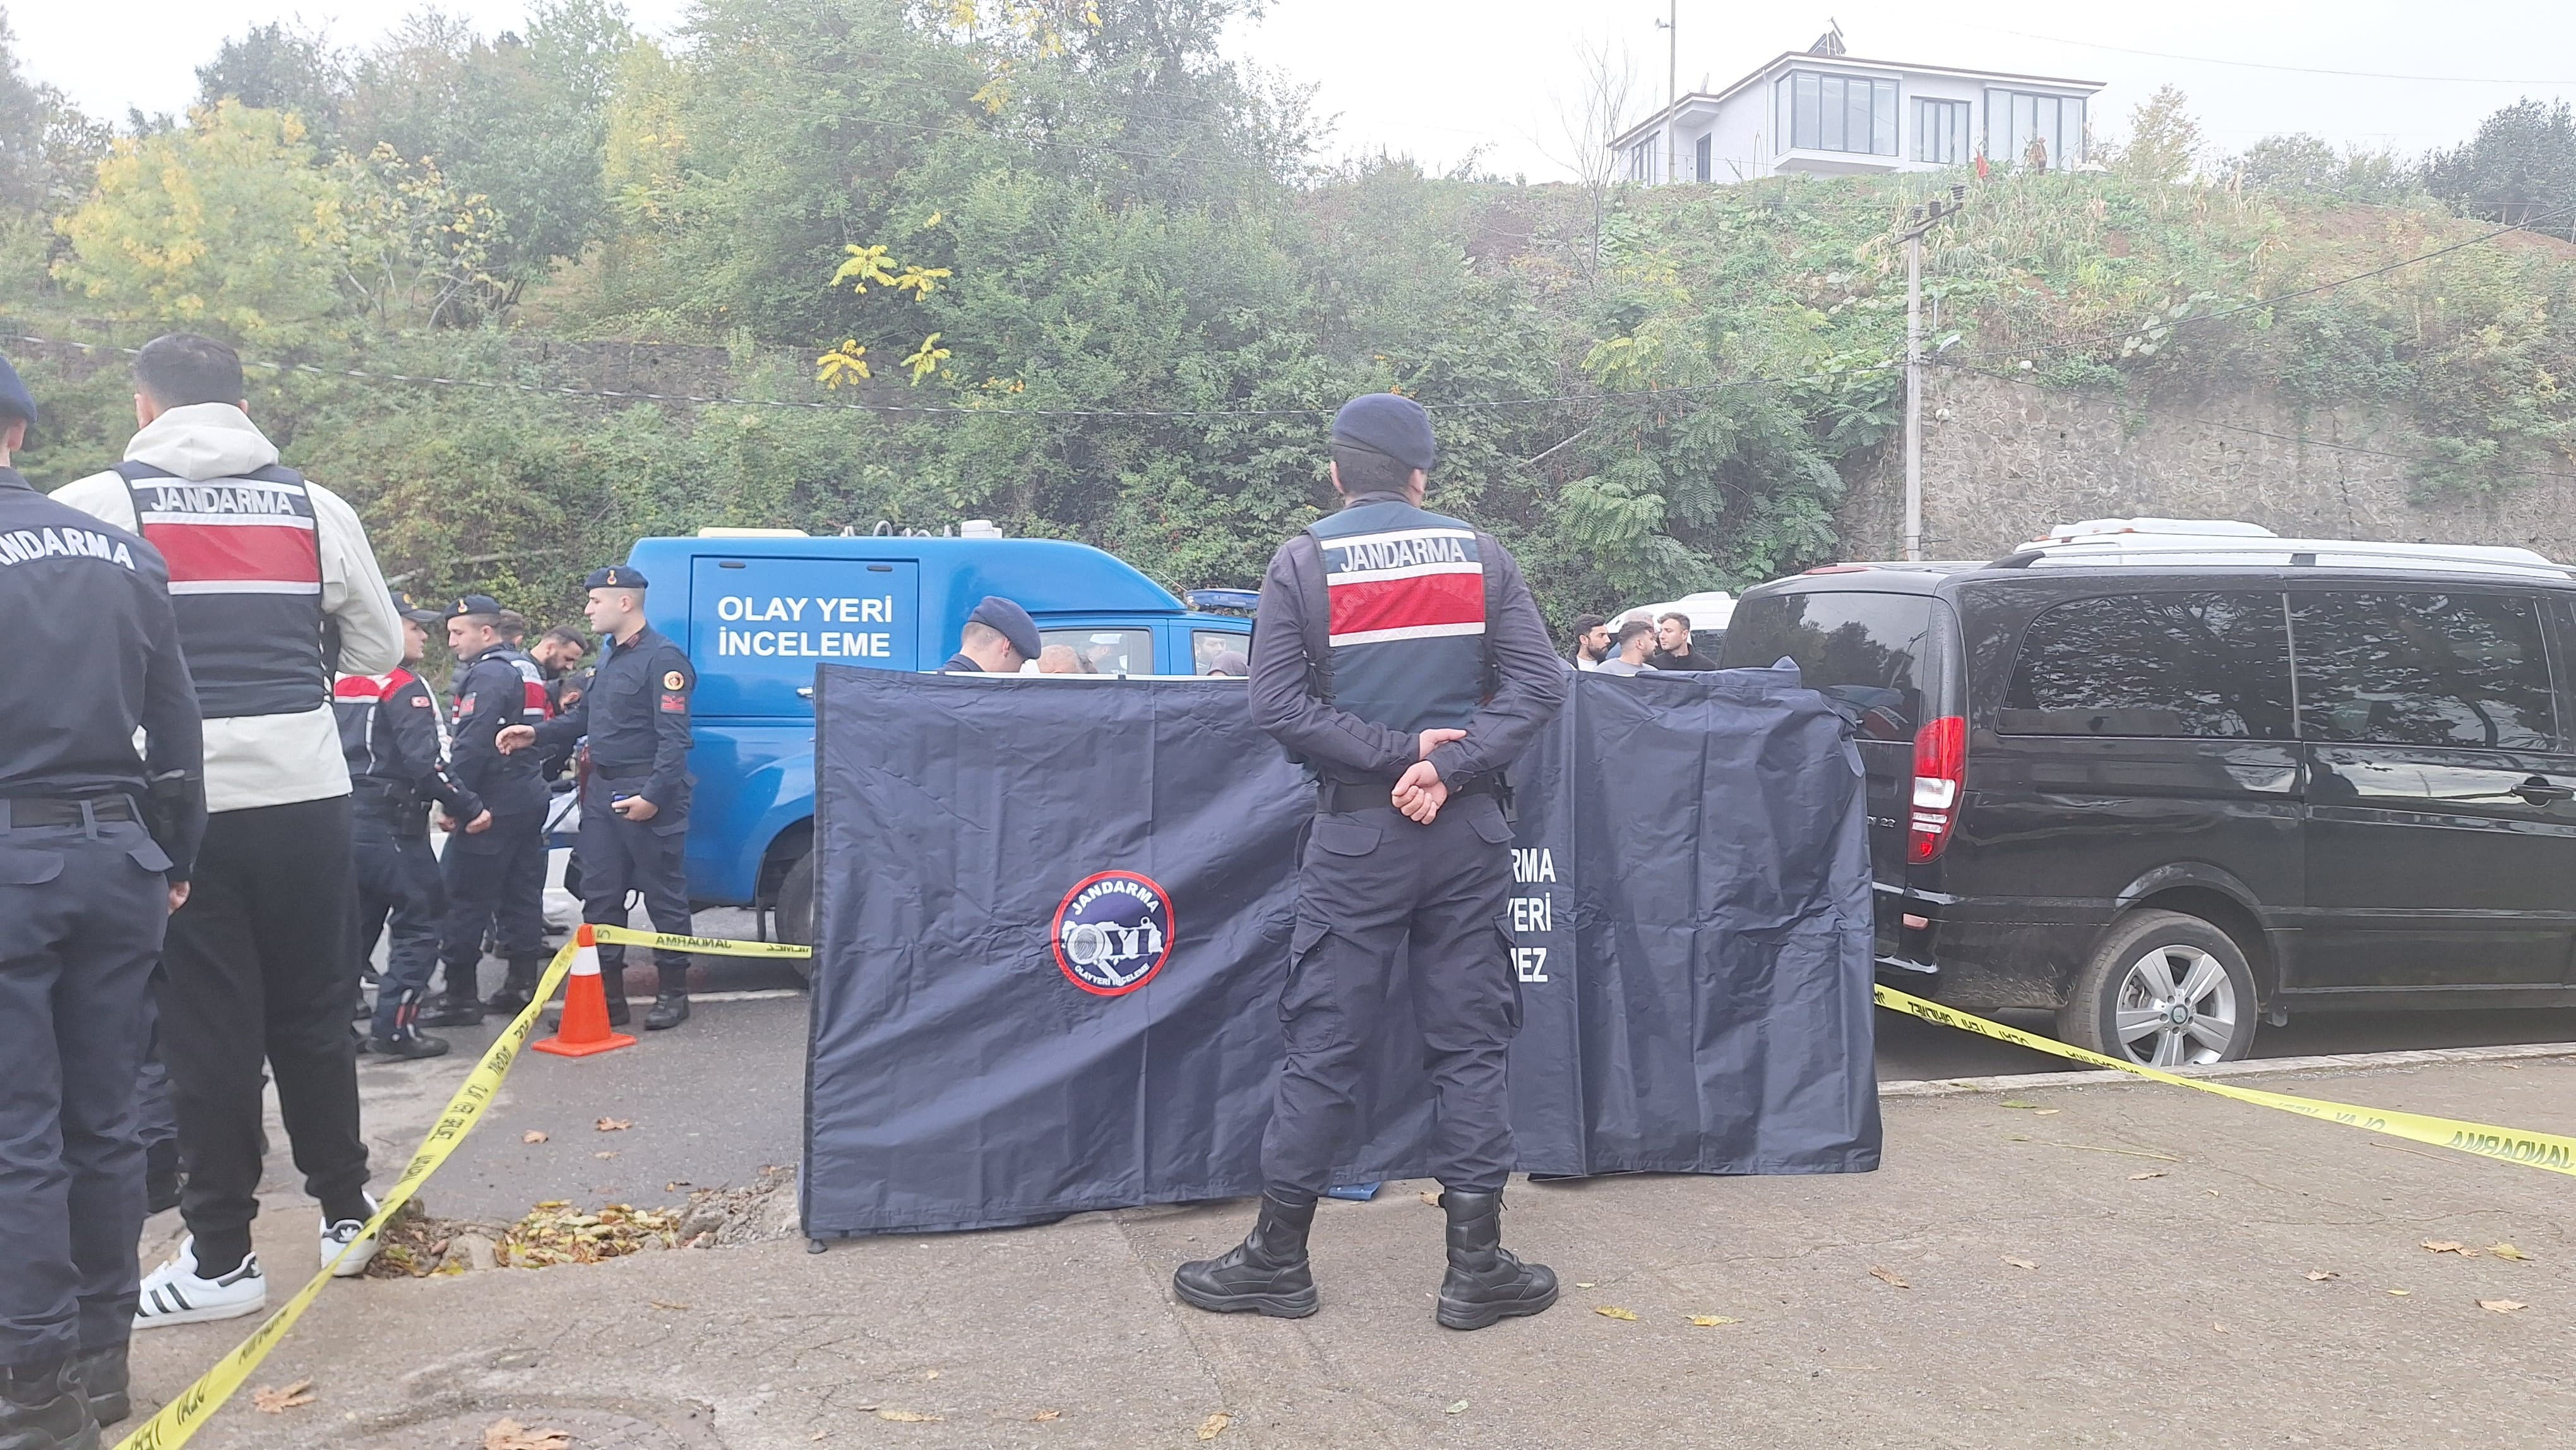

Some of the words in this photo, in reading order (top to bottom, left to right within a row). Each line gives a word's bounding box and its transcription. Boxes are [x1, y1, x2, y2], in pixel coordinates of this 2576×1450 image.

[150, 487, 295, 515] JANDARMA
[0, 527, 136, 570] NDARMA
[1340, 537, 1468, 572] JANDARMA
[718, 596, 808, 621] OLAY
[816, 595, 892, 623] YERİ
[719, 626, 890, 657] İNCELEME
[1510, 848, 1556, 882] RMA
[1071, 880, 1159, 916] JANDARMA
